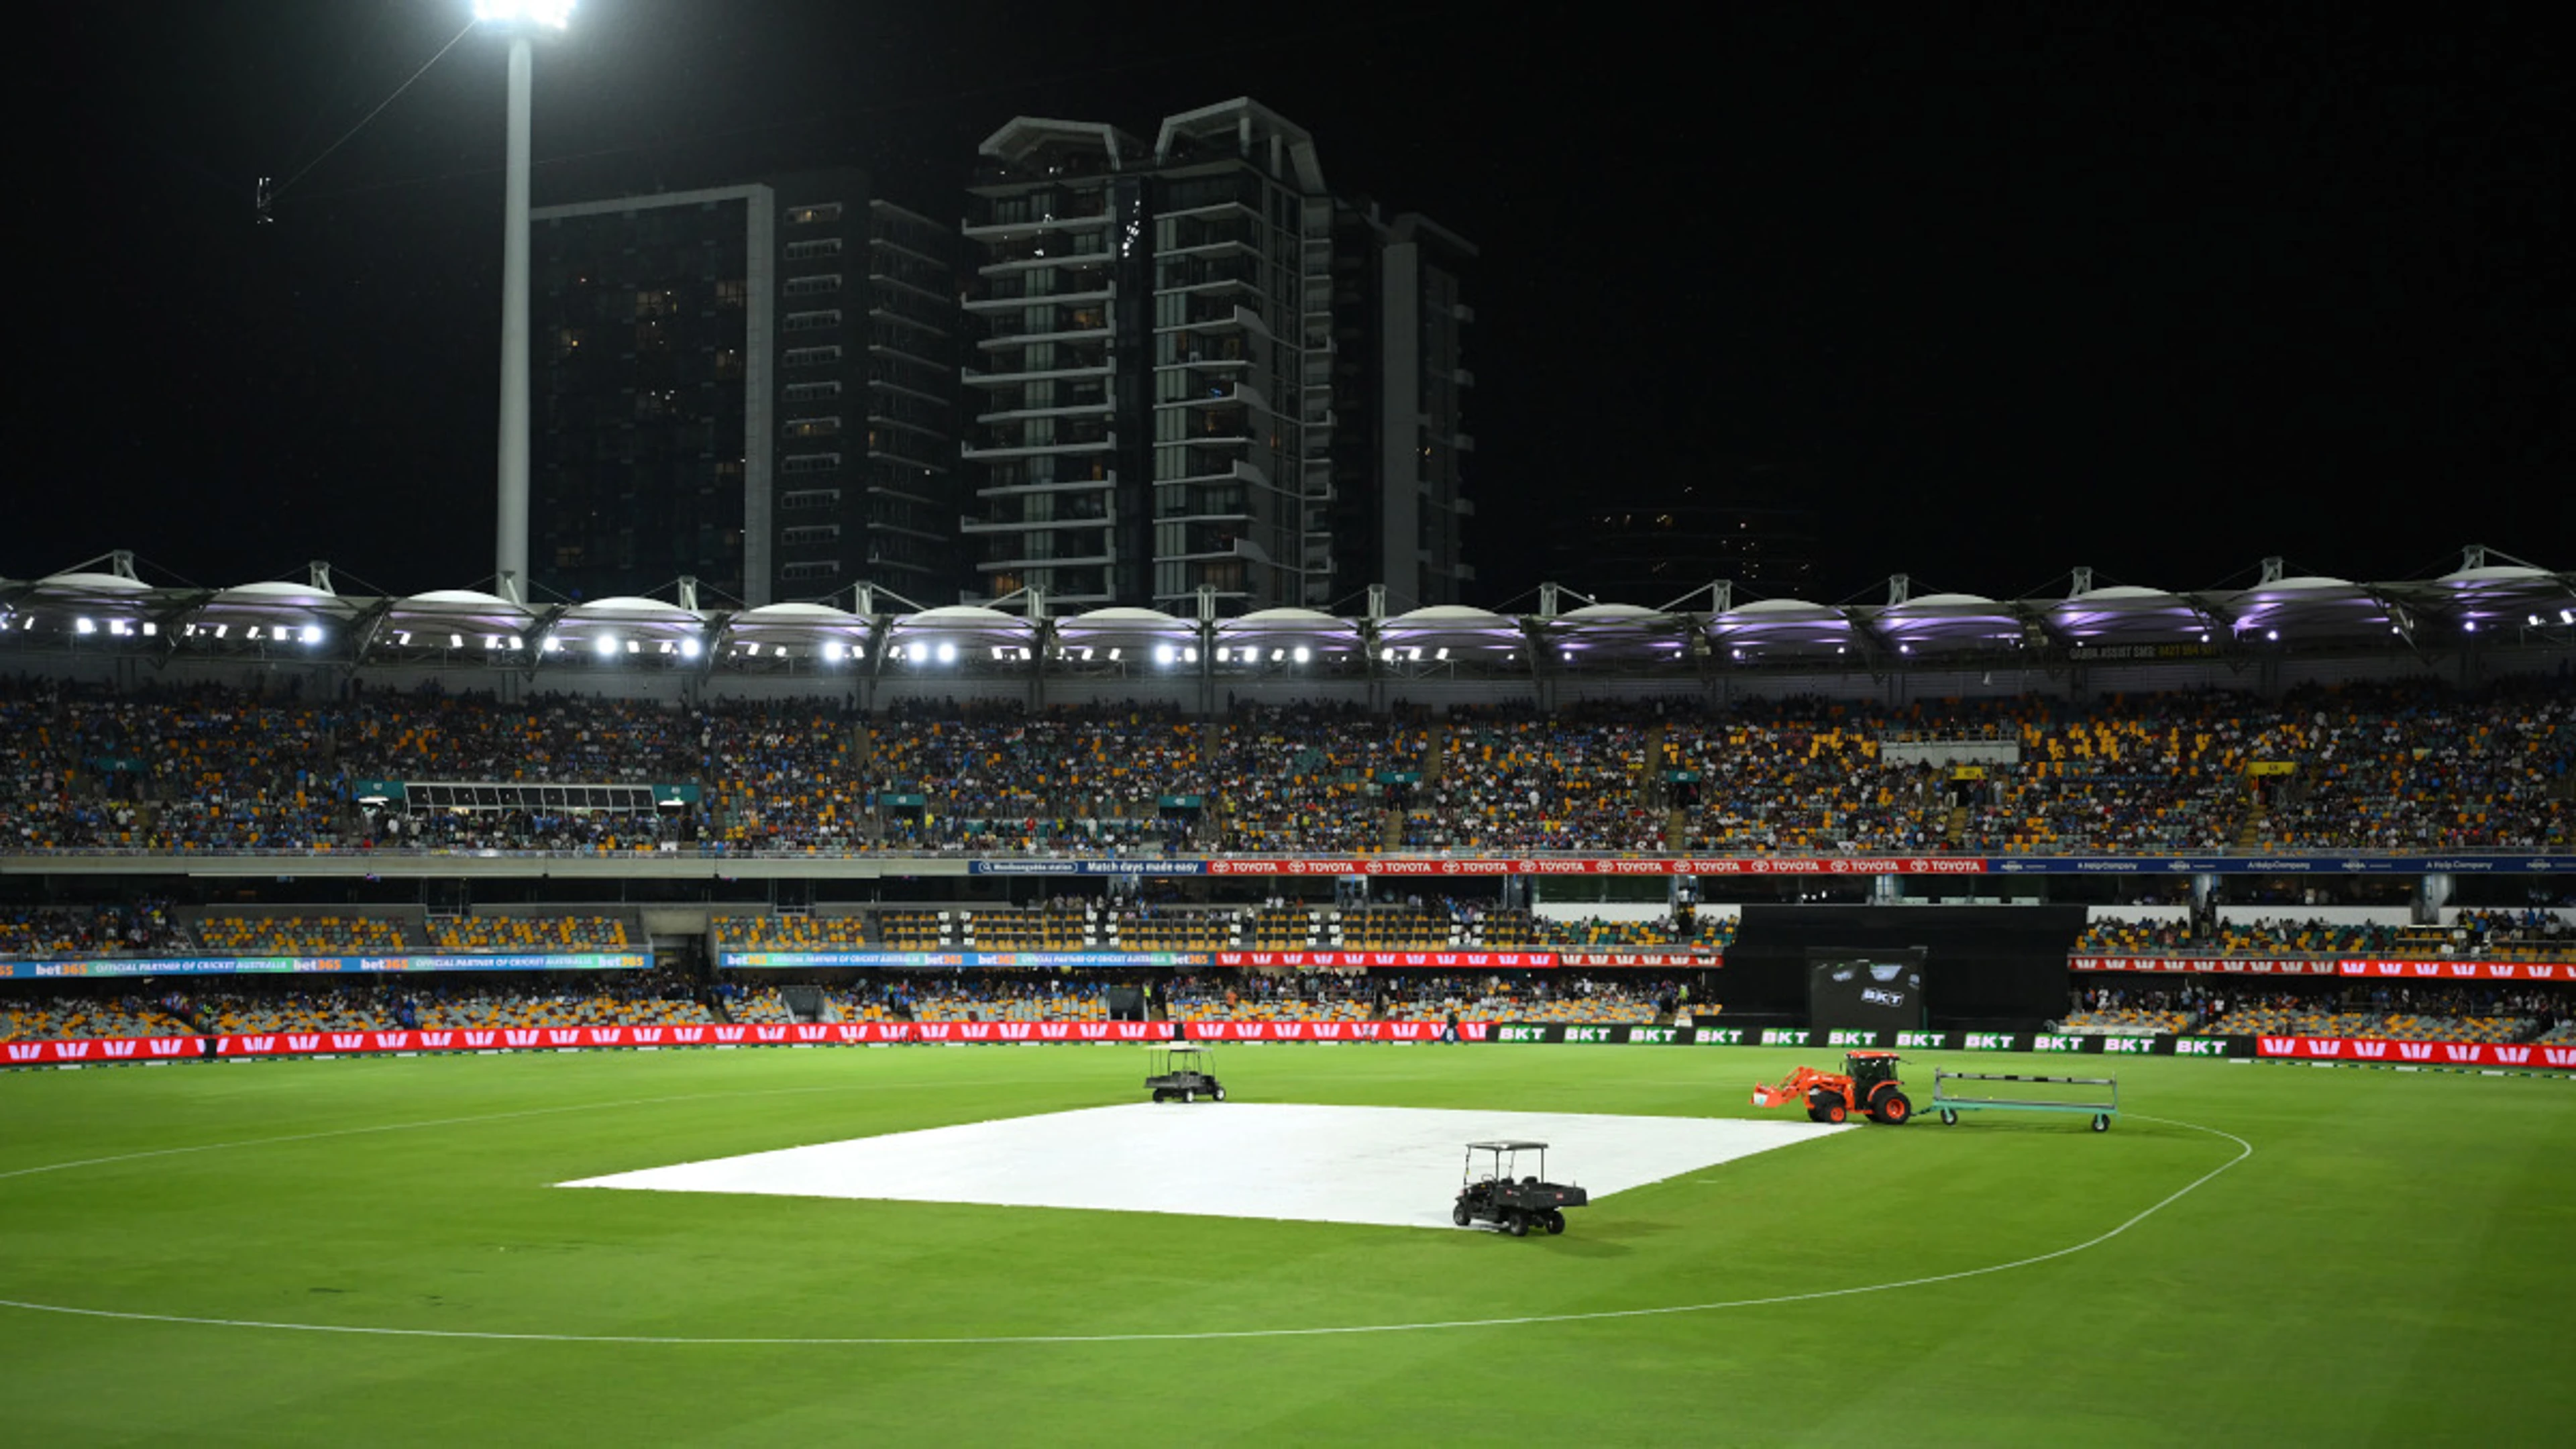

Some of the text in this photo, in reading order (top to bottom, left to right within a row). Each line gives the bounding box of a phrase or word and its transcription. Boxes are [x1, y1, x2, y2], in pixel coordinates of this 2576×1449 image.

[1087, 861, 1199, 873] Match days made easy
[1232, 862, 1277, 872] TOYOTA
[1309, 862, 1354, 872] TOYOTA
[1385, 862, 1430, 872] TOYOTA
[1462, 862, 1507, 872] TOYOTA
[1539, 861, 1584, 871] TOYOTA
[1617, 861, 1662, 871] TOYOTA
[1694, 861, 1739, 871] TOYOTA
[1774, 861, 1819, 871] TOYOTA
[1853, 861, 1898, 871] TOYOTA
[1933, 861, 1979, 871] TOYOTA
[293, 959, 341, 970] bet365
[360, 959, 409, 970] bet365
[416, 959, 454, 967] OFFICIAL
[455, 959, 494, 967] PARTNER
[496, 958, 508, 967] OF
[510, 958, 543, 966] CRICKET
[598, 956, 645, 967] bet365
[727, 955, 767, 965] bet365
[925, 954, 963, 965] bet365
[978, 954, 1016, 965] bet365
[1170, 954, 1209, 965] bet365
[36, 963, 87, 975] bet365
[95, 963, 136, 973] OFFICIAL
[140, 962, 180, 971] PARTNER
[182, 961, 195, 970] OF
[197, 961, 235, 970] CRICKET
[1499, 1028, 1545, 1039] BKT
[1565, 1028, 1610, 1040] BKT
[1630, 1029, 1676, 1041] BKT
[1696, 1030, 1741, 1042] BKT
[1762, 1031, 1809, 1043] BKT
[1829, 1032, 1876, 1044] BKT
[1897, 1034, 1944, 1046] BKT
[1966, 1035, 2014, 1048] BKT
[2035, 1036, 2083, 1049] BKT
[2104, 1038, 2154, 1051] BKT
[2176, 1040, 2226, 1054] BKT
